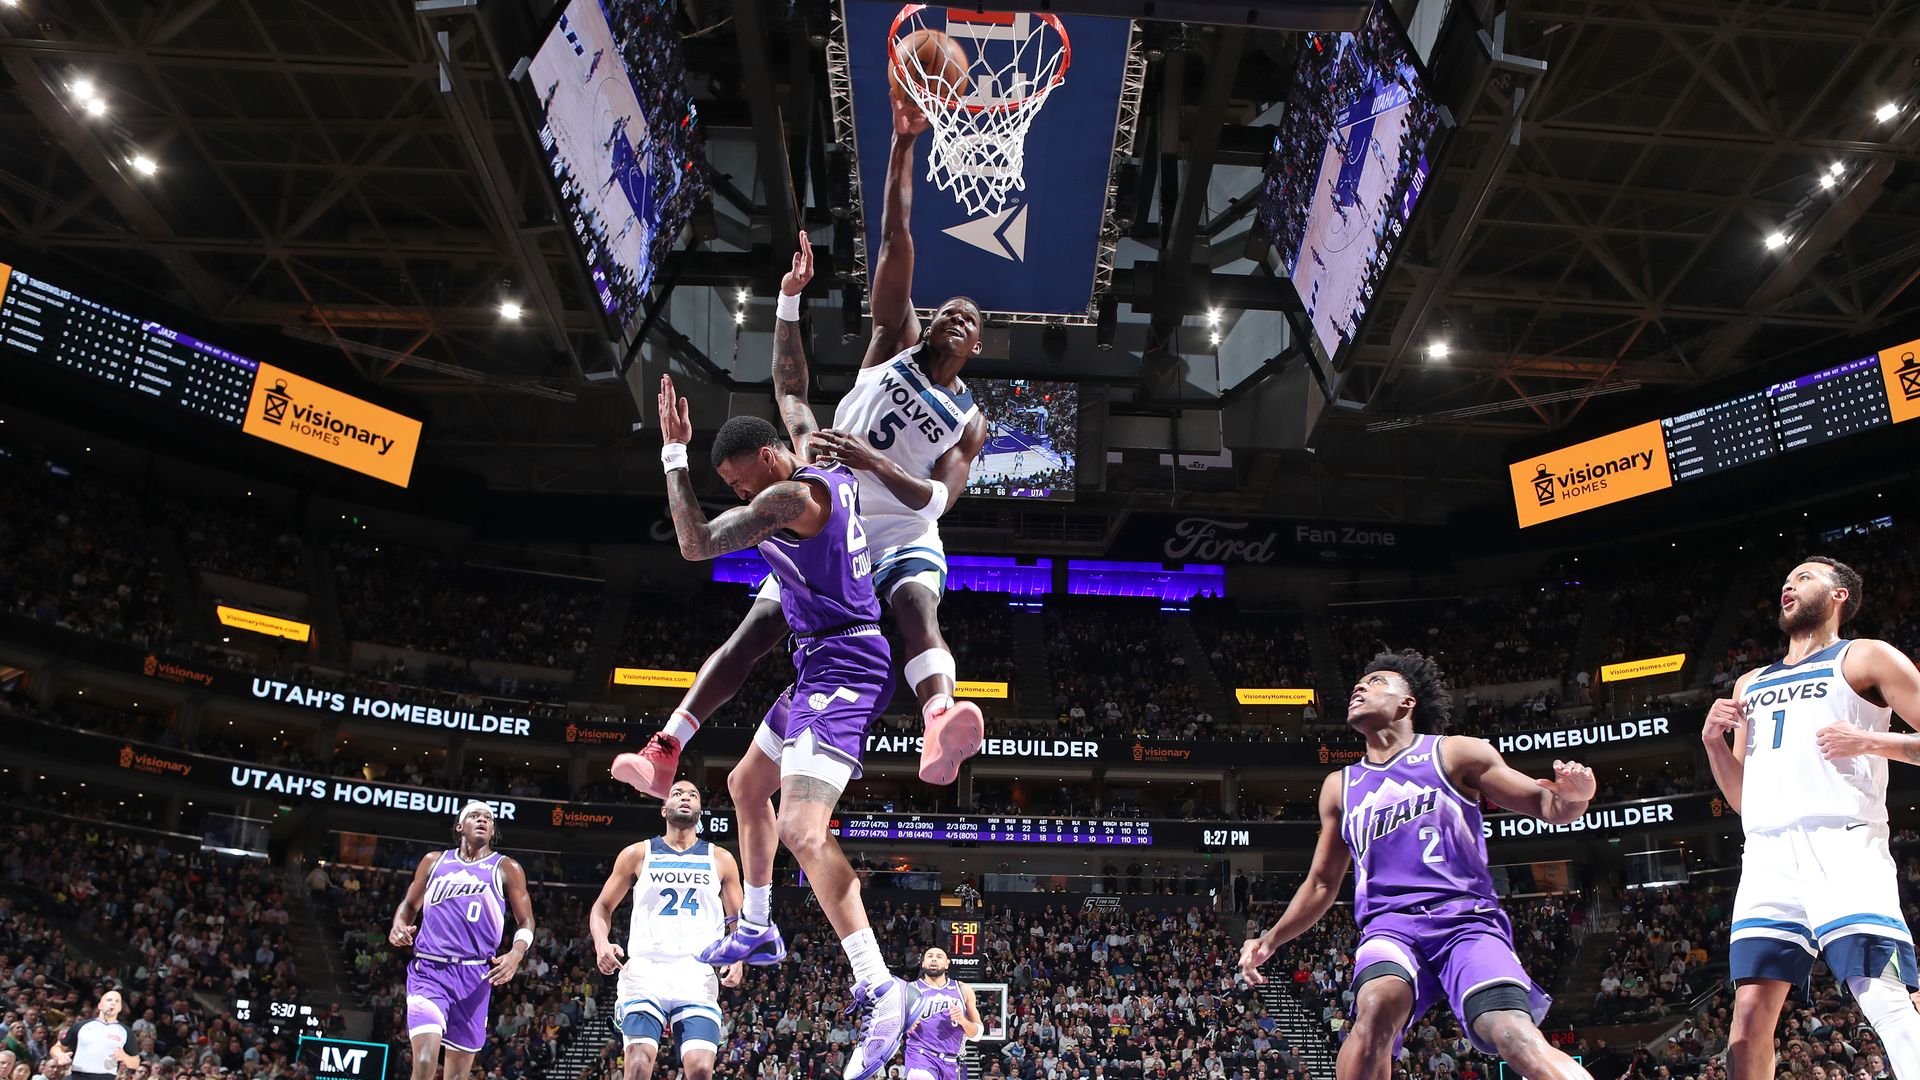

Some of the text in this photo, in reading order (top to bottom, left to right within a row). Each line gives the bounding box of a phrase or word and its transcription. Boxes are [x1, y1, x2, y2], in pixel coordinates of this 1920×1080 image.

[1411, 167, 1426, 192] UTA
[1392, 219, 1403, 238] 66
[157, 327, 178, 340] JAZZ
[1780, 380, 1797, 392] JAZZ
[1777, 392, 1797, 402] SEXTON
[879, 372, 944, 443] WOLVES
[1782, 414, 1803, 425] COLLINS
[290, 420, 341, 447] HOMES
[292, 403, 395, 456] visionary
[868, 411, 907, 450] 5
[1677, 446, 1697, 456] WARREN
[1786, 438, 1808, 448] GEORGE
[1557, 448, 1654, 489] visionary
[1678, 456, 1704, 467] ANDERSON
[1681, 467, 1704, 478] EDWARDS
[997, 488, 1006, 496] 66
[1031, 489, 1043, 497] UTA
[1561, 478, 1608, 500] HOMES
[838, 481, 868, 553] 2
[1164, 517, 1277, 563] Ford
[1296, 525, 1396, 546] Fan Zone
[159, 663, 214, 686] visionary
[622, 673, 688, 682] VisionaryHomes.com
[1610, 661, 1678, 675] VisionaryHomes.com
[1747, 682, 1828, 712] WOLVES
[252, 678, 531, 736] UTAH'S HOMEBUILDER
[578, 728, 626, 742] visionary
[1499, 717, 1670, 753] HOMEBUILDER
[1772, 709, 1786, 749] 1
[865, 735, 1099, 758] TAH'S EBUILDER
[1144, 747, 1191, 759] visionary
[1330, 749, 1366, 758] visiona
[135, 754, 192, 776] visionary
[1406, 753, 1431, 764] LVT
[231, 766, 516, 820] UTAH'S HOMEBUILER
[564, 811, 613, 825] visionary
[710, 817, 729, 832] 65
[829, 819, 839, 827] 20
[850, 820, 870, 828] 27/57
[870, 820, 889, 829] (47%)
[915, 822, 934, 830] (39%)
[960, 823, 977, 831] (67%)
[1350, 788, 1441, 861] UTAH
[870, 830, 888, 838] (47%)
[898, 830, 913, 838] 8/18
[914, 831, 933, 839] (44%)
[959, 832, 978, 840] (80%)
[1203, 830, 1249, 846] 8:27 PM
[1419, 826, 1444, 864] 2
[650, 872, 710, 885] WOLVES
[431, 880, 489, 905] UTAH
[658, 888, 699, 916] 24
[466, 902, 481, 922] 0
[951, 922, 977, 934] 5:30
[955, 934, 975, 955] 19
[237, 1009, 250, 1020] 65
[270, 1002, 296, 1018] 5:30
[306, 1016, 319, 1027] 66
[320, 1046, 368, 1075] LVT
